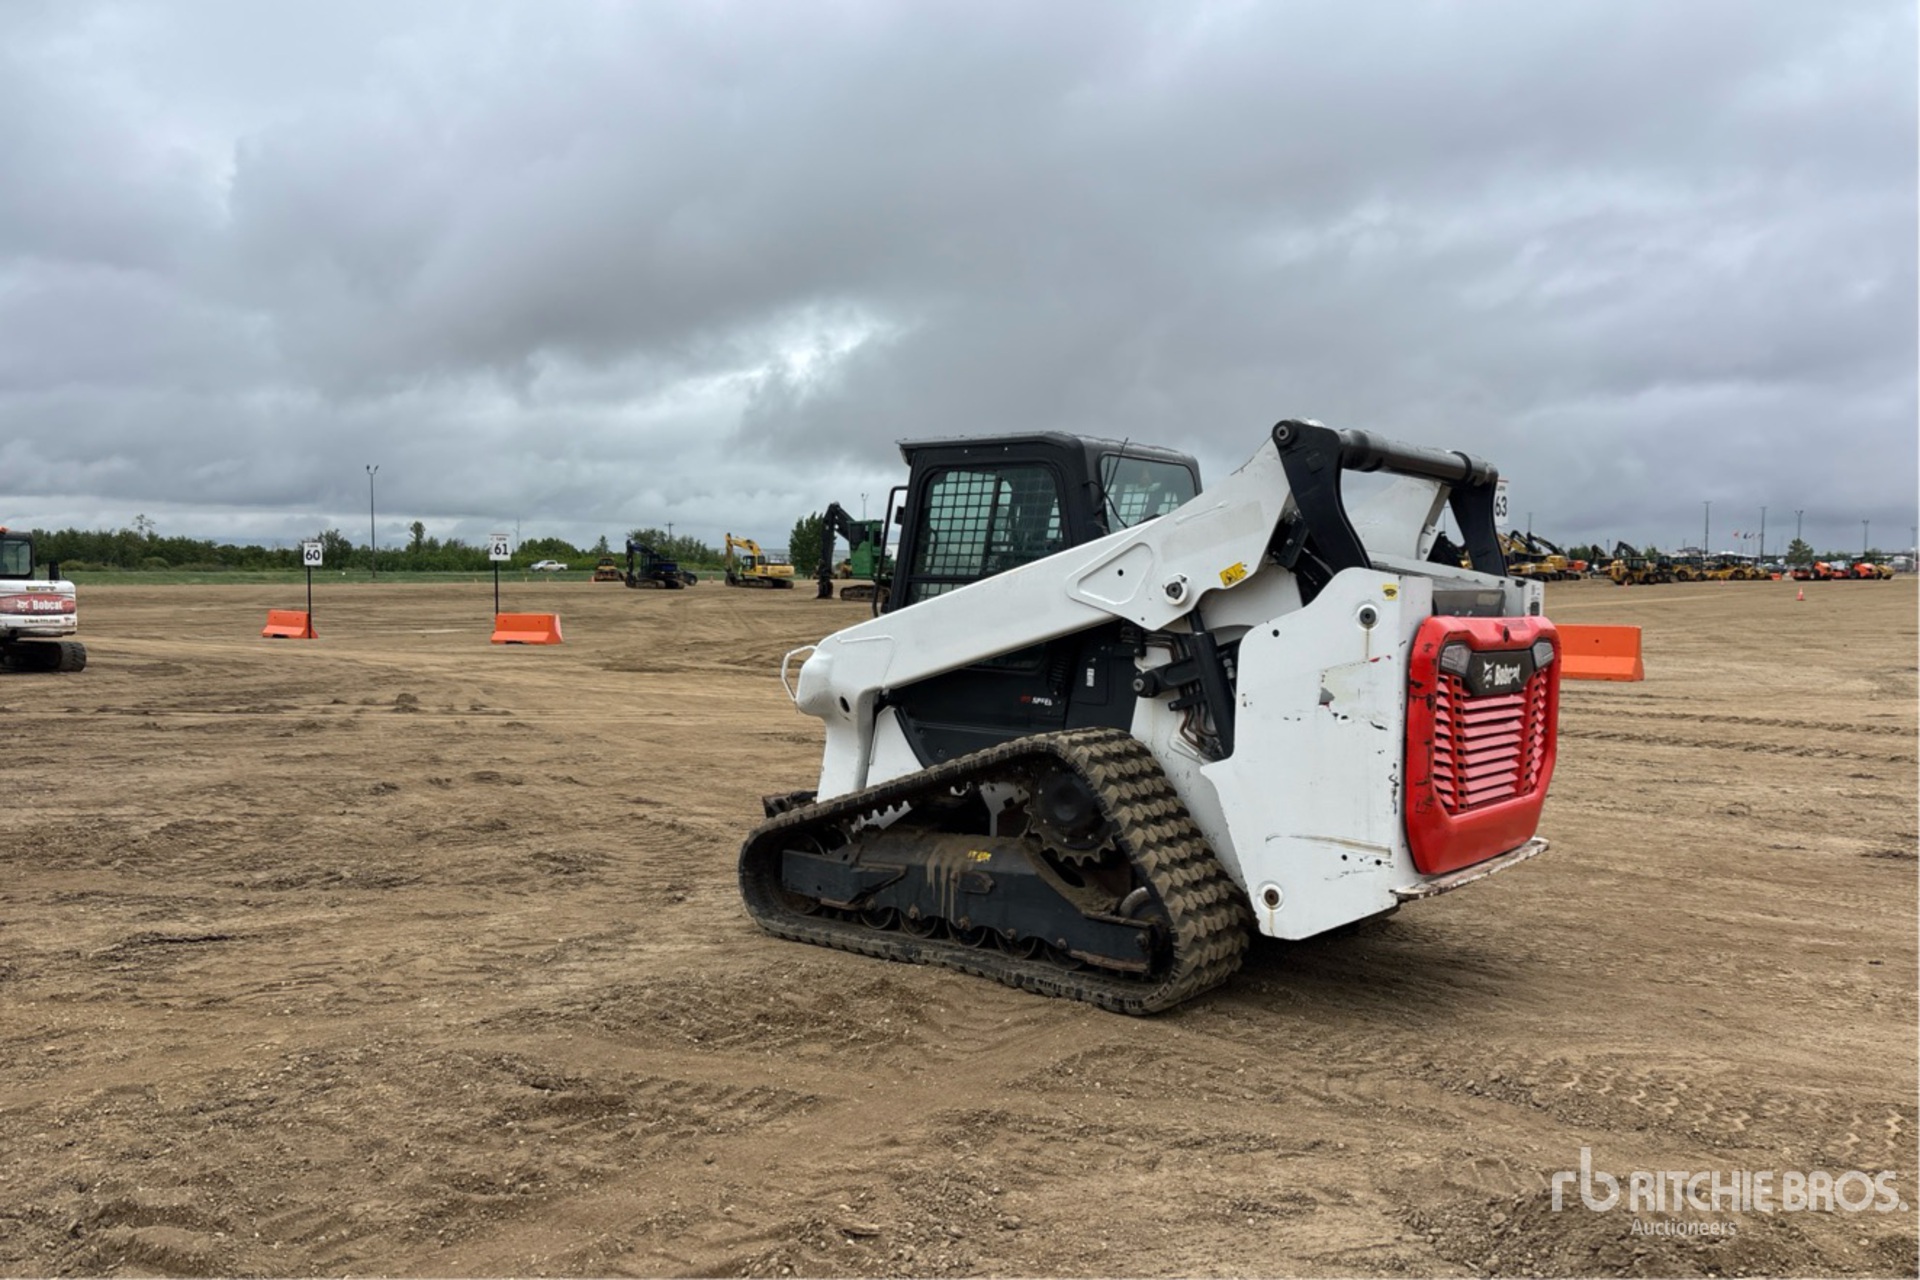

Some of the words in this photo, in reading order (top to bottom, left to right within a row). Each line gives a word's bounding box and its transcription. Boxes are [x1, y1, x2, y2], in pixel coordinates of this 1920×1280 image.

[1495, 496, 1507, 517] 63
[305, 550, 320, 560] 60
[494, 543, 508, 555] 61
[32, 600, 62, 610] Bobcat
[1494, 664, 1521, 686] Bobcat
